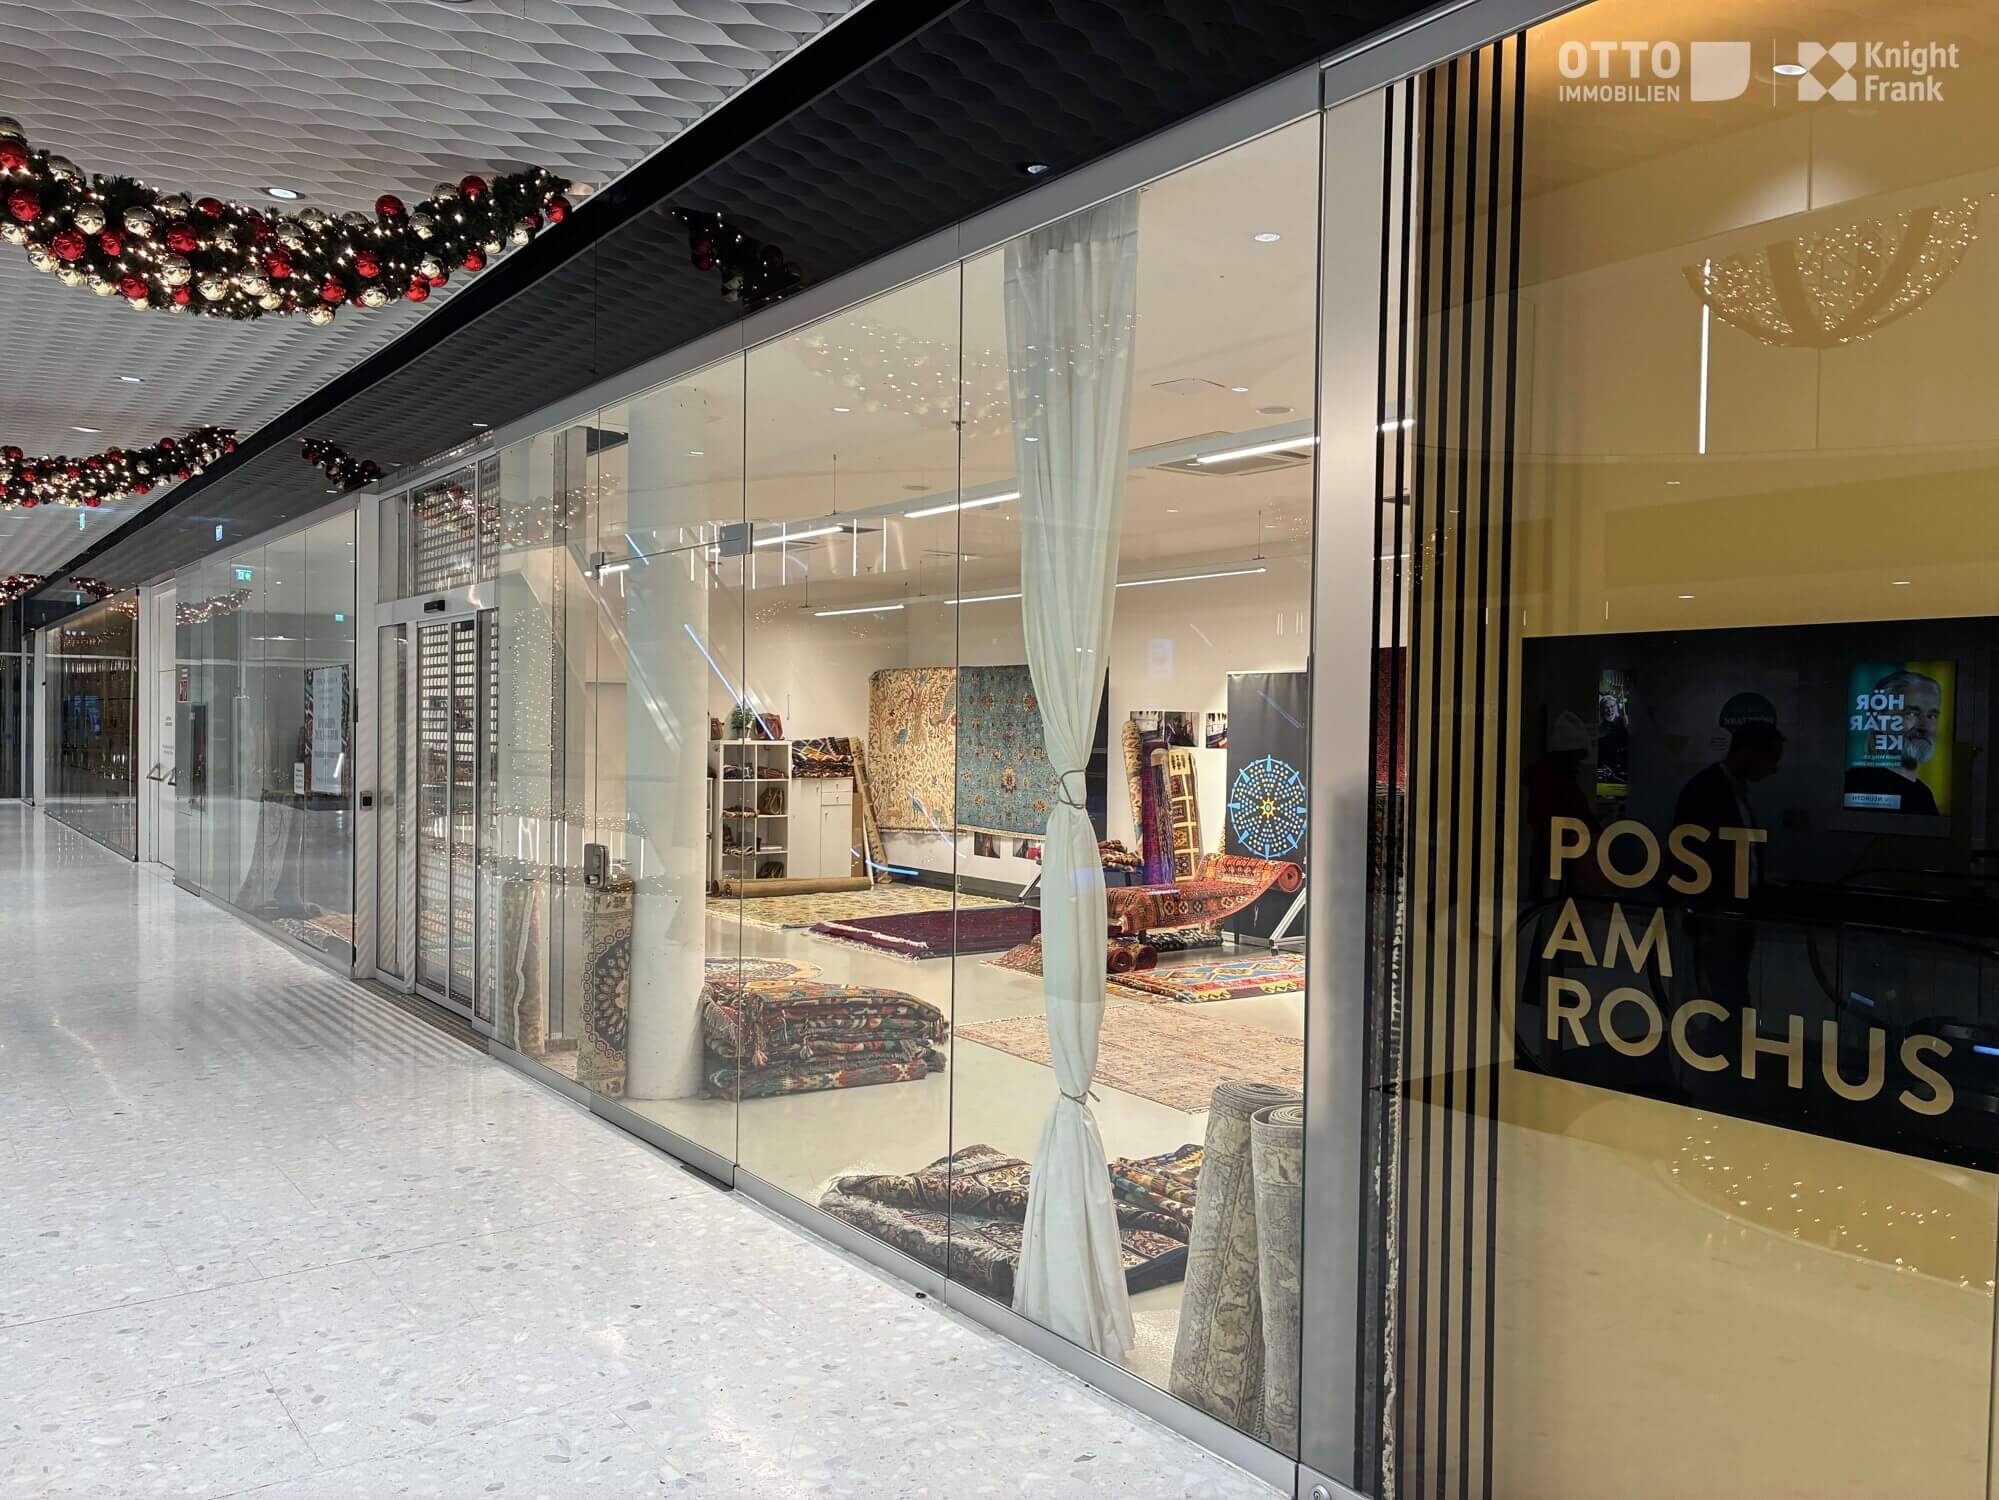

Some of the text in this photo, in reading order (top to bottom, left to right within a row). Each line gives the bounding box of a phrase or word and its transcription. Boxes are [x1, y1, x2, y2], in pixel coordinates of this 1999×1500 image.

[1550, 816, 1767, 899] POST
[1542, 897, 1673, 977] AM
[1546, 976, 1954, 1116] ROCHUS
